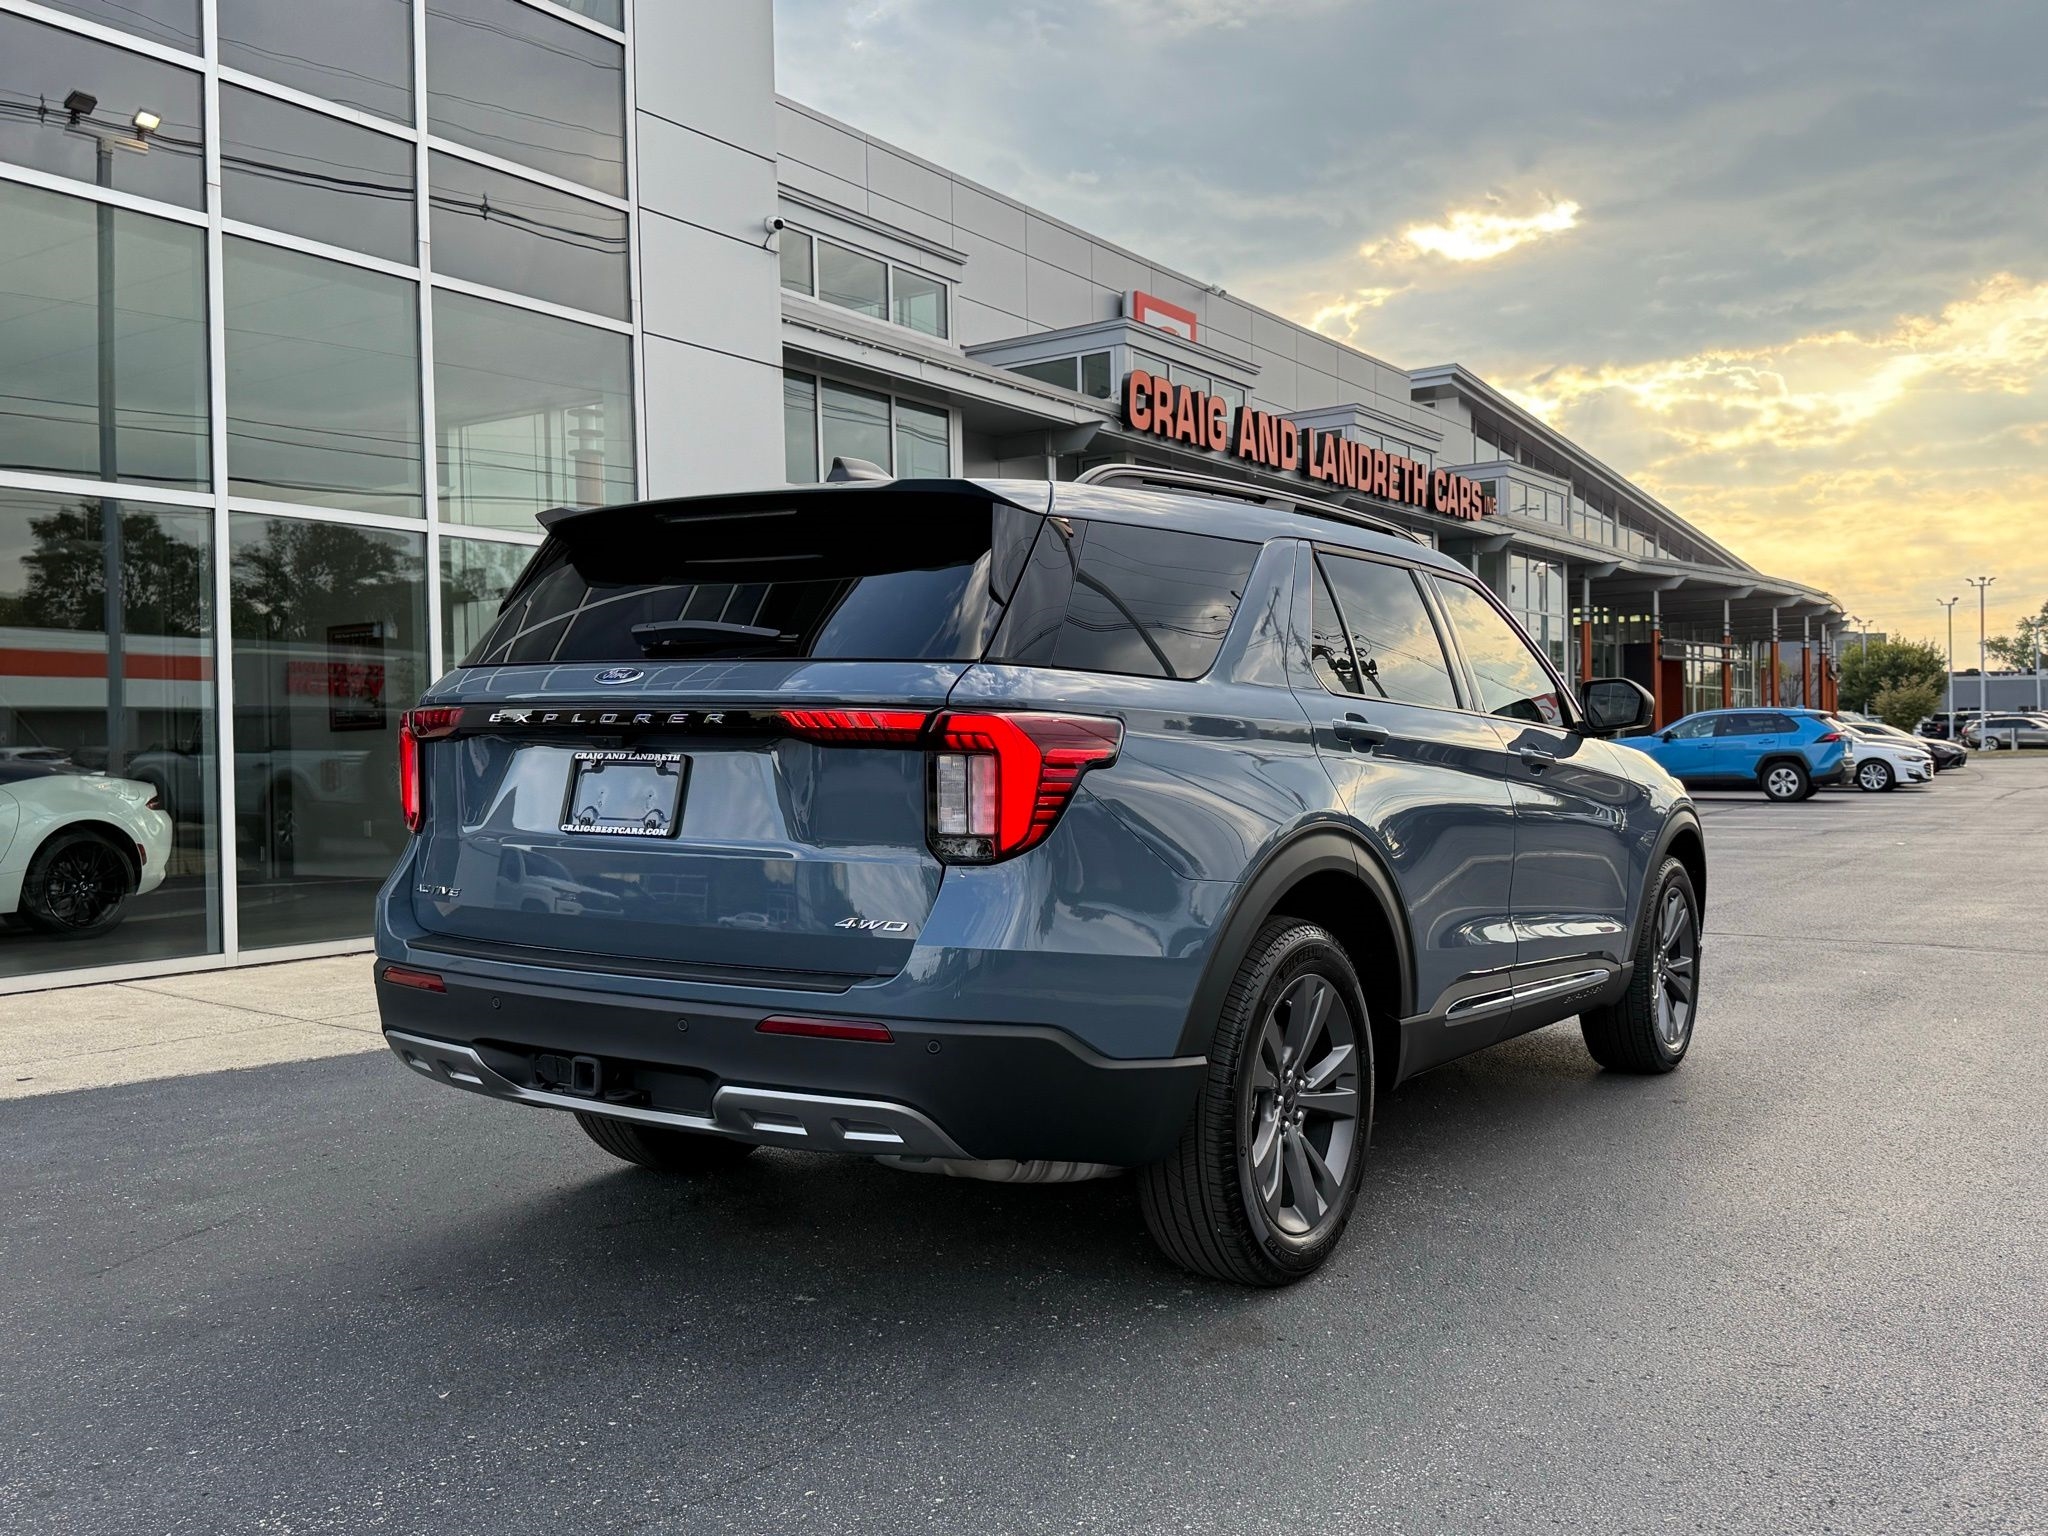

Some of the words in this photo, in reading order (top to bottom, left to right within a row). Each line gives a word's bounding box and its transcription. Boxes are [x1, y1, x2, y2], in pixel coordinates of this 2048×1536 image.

[1128, 369, 1228, 452] CRAIG
[1238, 405, 1298, 471] AND
[1308, 426, 1427, 508] LANDRETH
[1434, 467, 1483, 522] CARS
[488, 712, 727, 724] EXPLORER
[574, 752, 604, 760] CRAIG
[604, 752, 626, 760] AND
[627, 752, 681, 762] LANDRETH
[560, 824, 668, 836] CRAIGSBESTCARS.COM
[834, 917, 909, 932] 4WD
